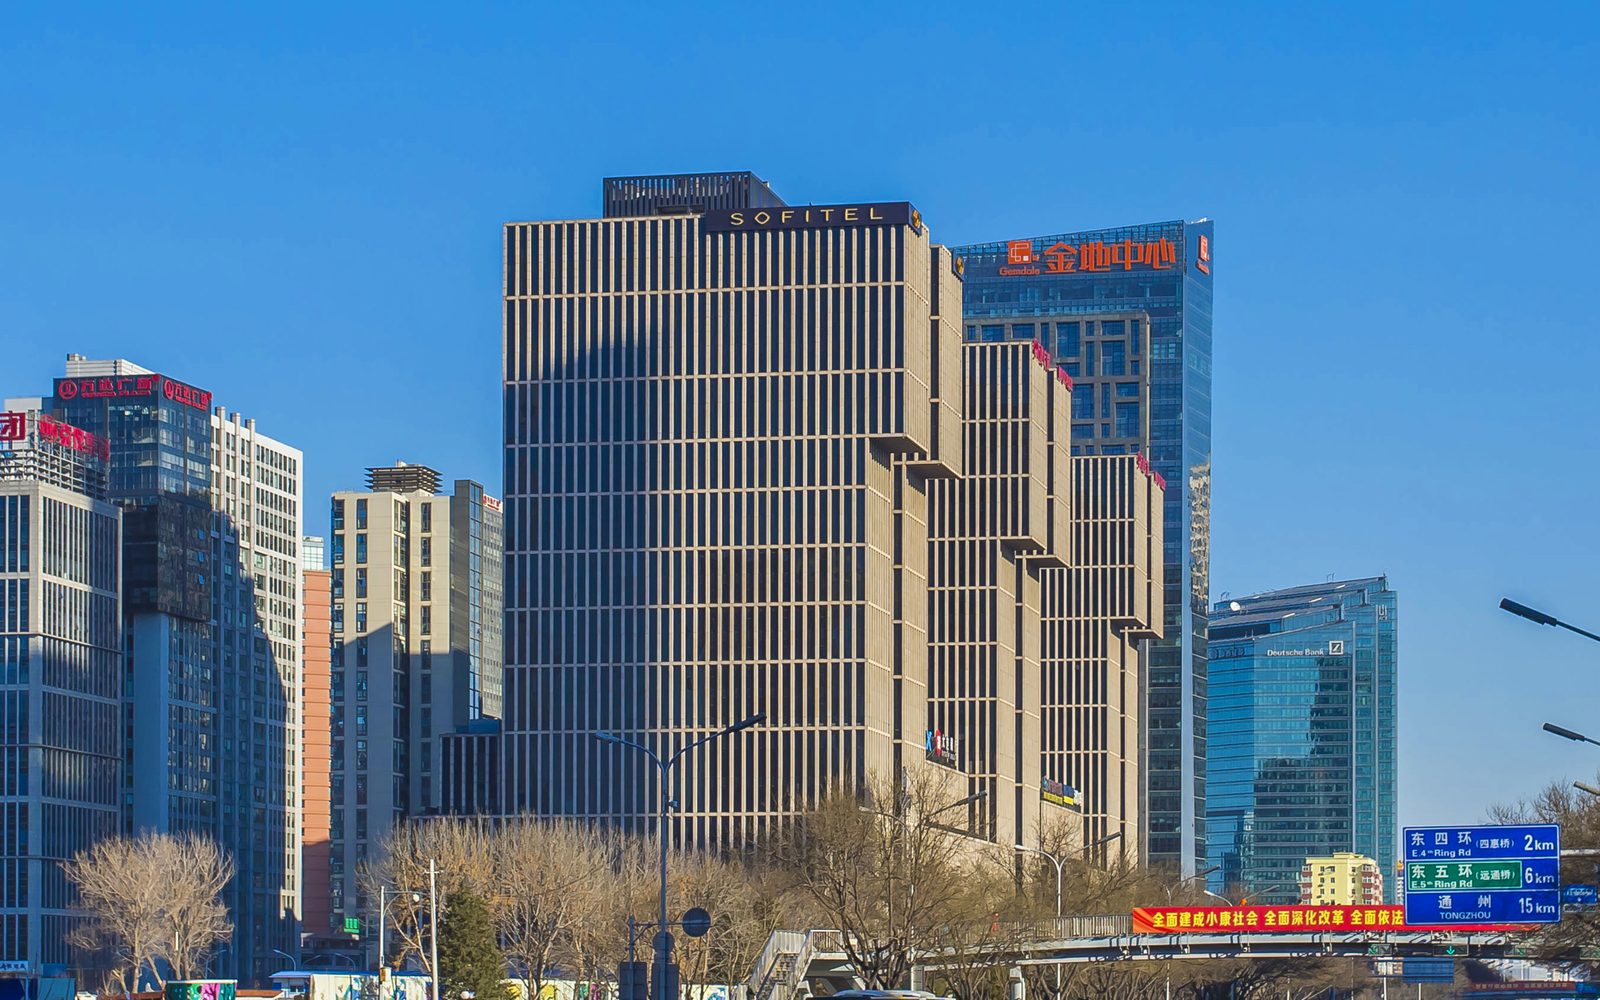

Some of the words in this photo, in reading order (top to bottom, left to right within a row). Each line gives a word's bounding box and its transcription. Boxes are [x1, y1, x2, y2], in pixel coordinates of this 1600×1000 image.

[730, 207, 883, 226] SOFITEL
[1044, 237, 1176, 273] 金地中心
[1267, 649, 1303, 657] Deutsche
[1304, 648, 1324, 656] Bank
[1411, 831, 1472, 846] 东四环
[1434, 849, 1456, 858] Ring
[1458, 849, 1472, 857] Rd
[1411, 864, 1473, 879] 东五环
[1434, 880, 1457, 889] Ring
[1459, 880, 1473, 888] Rd
[1438, 894, 1492, 910] 通州
[1152, 911, 1259, 928] 全面建成小康社会
[1264, 910, 1345, 926] 全面深化改革
[1440, 911, 1491, 920] TONGZHOU
